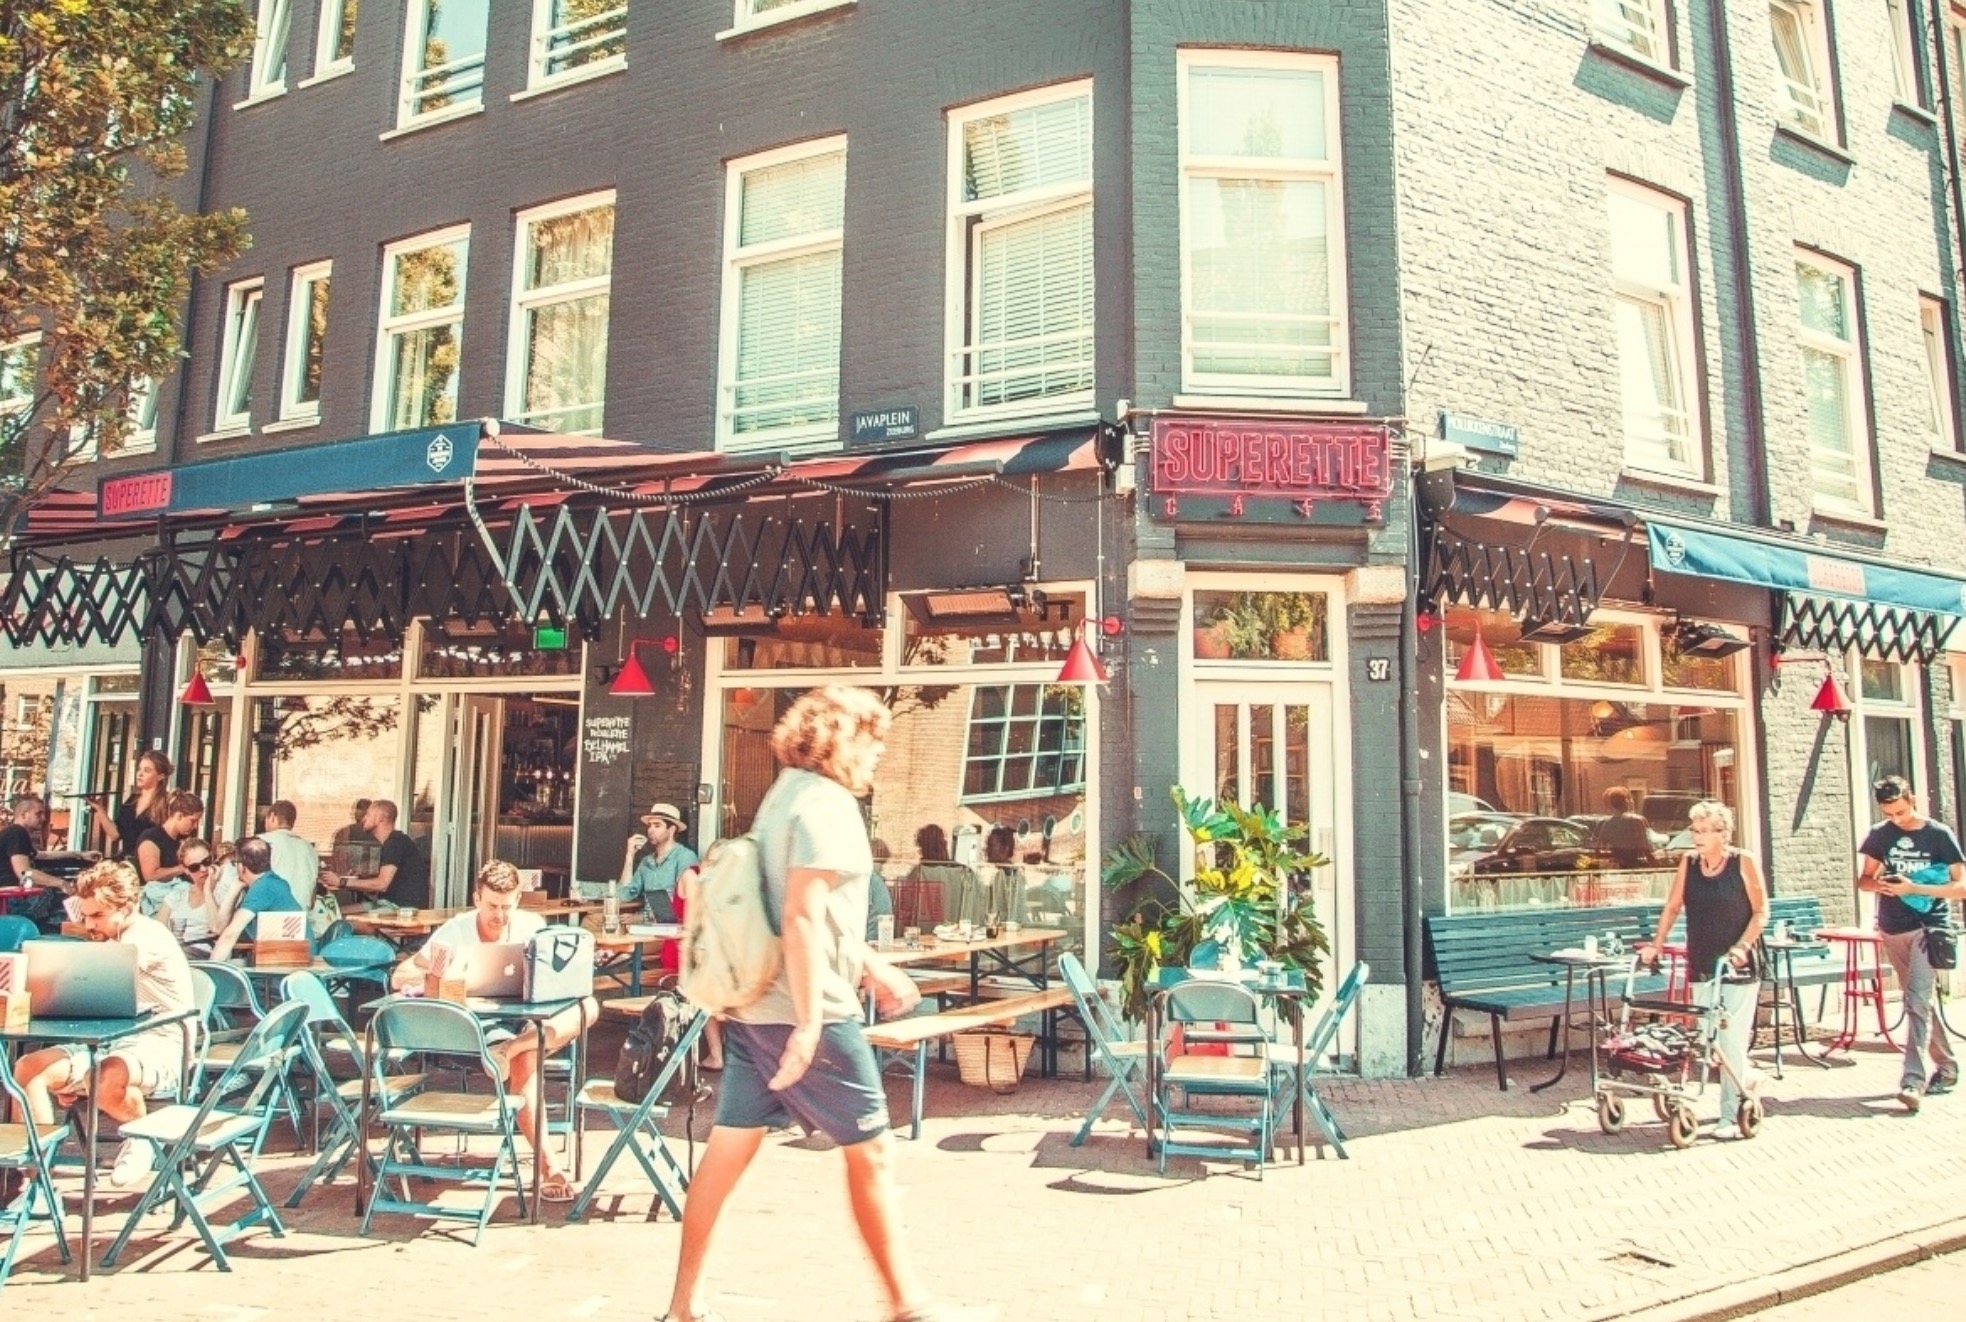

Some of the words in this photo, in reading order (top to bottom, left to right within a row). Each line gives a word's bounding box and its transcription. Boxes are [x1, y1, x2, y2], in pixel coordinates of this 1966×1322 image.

[856, 411, 910, 434] JAVAPLEIN
[1164, 429, 1380, 487] SUPERETTE
[105, 478, 168, 511] SUPERETTE
[1369, 659, 1389, 680] 37
